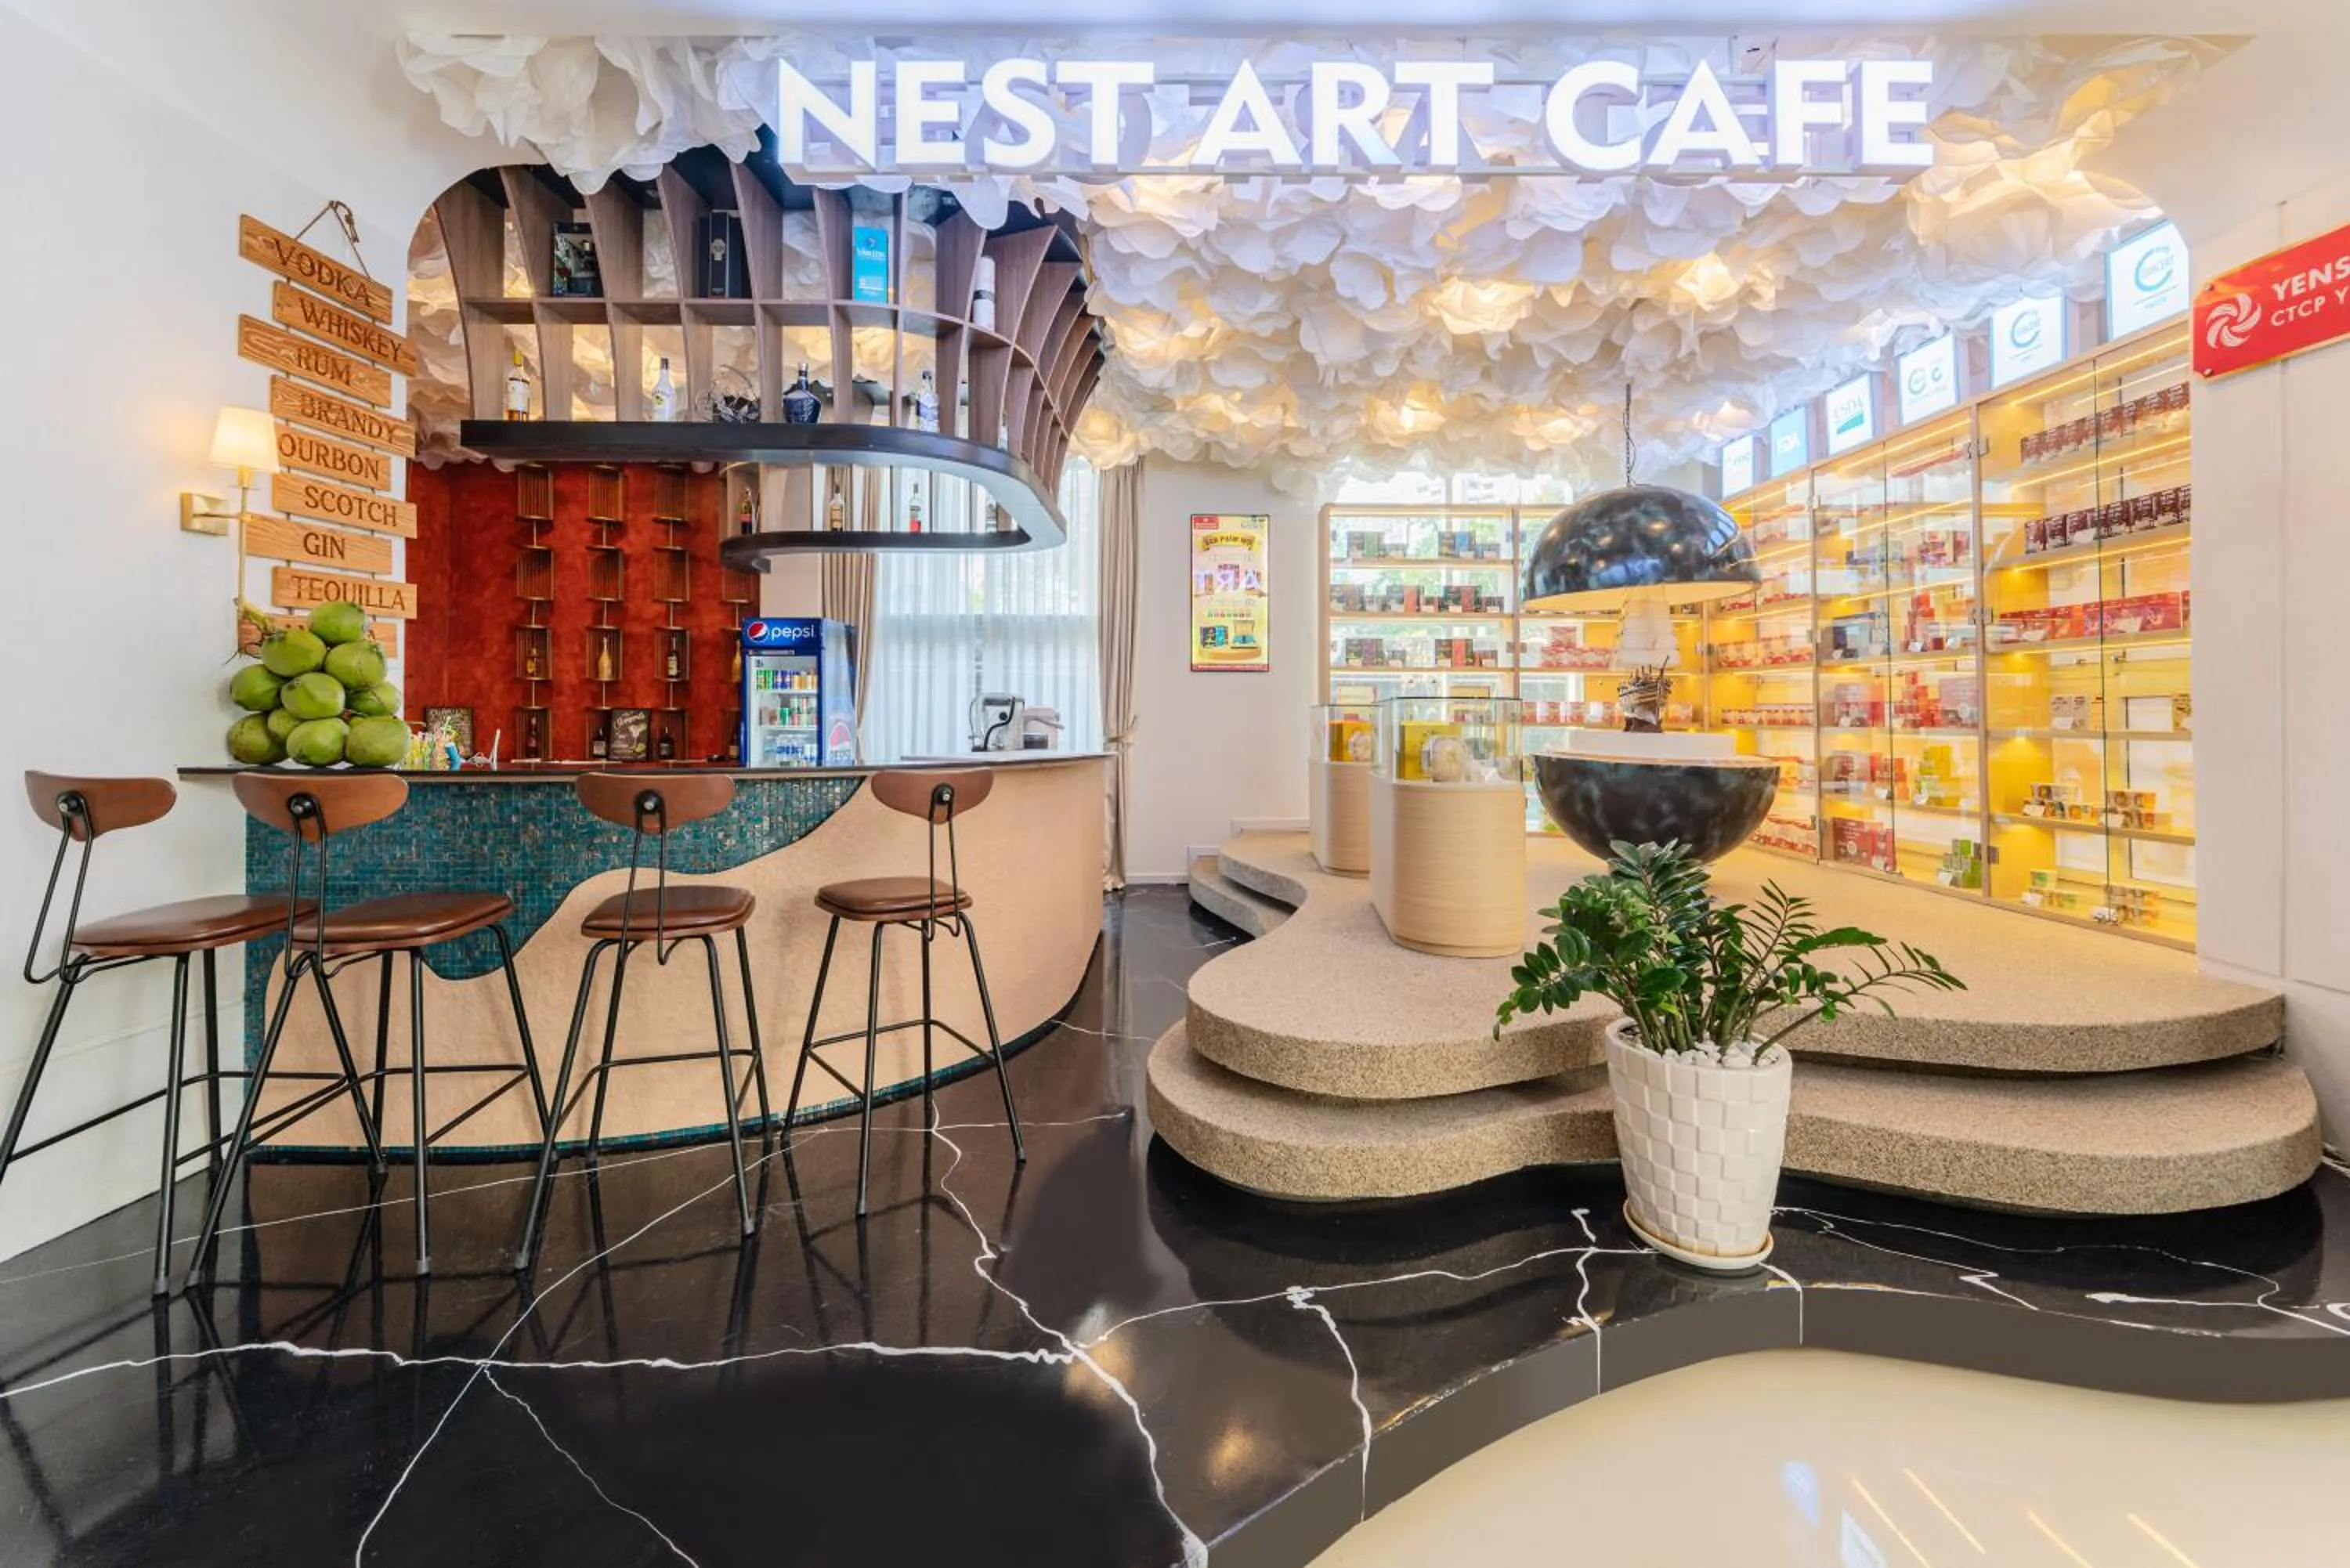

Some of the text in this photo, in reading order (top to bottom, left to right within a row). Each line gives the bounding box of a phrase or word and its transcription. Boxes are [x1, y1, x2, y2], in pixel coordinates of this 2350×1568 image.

[778, 57, 1933, 172] NEST ART CAFE
[274, 237, 372, 308] VODKA
[2272, 256, 2350, 302] YENS
[2271, 286, 2349, 327] CTCP Y
[299, 296, 402, 363] WHISKEY
[295, 346, 352, 386] RUM
[300, 393, 397, 444] BRANDY
[278, 433, 380, 482] OURBON
[305, 486, 397, 527] SCOTCH
[303, 532, 345, 560] GIN
[291, 576, 406, 611] TEQUILLA
[771, 624, 815, 641] pepsi
